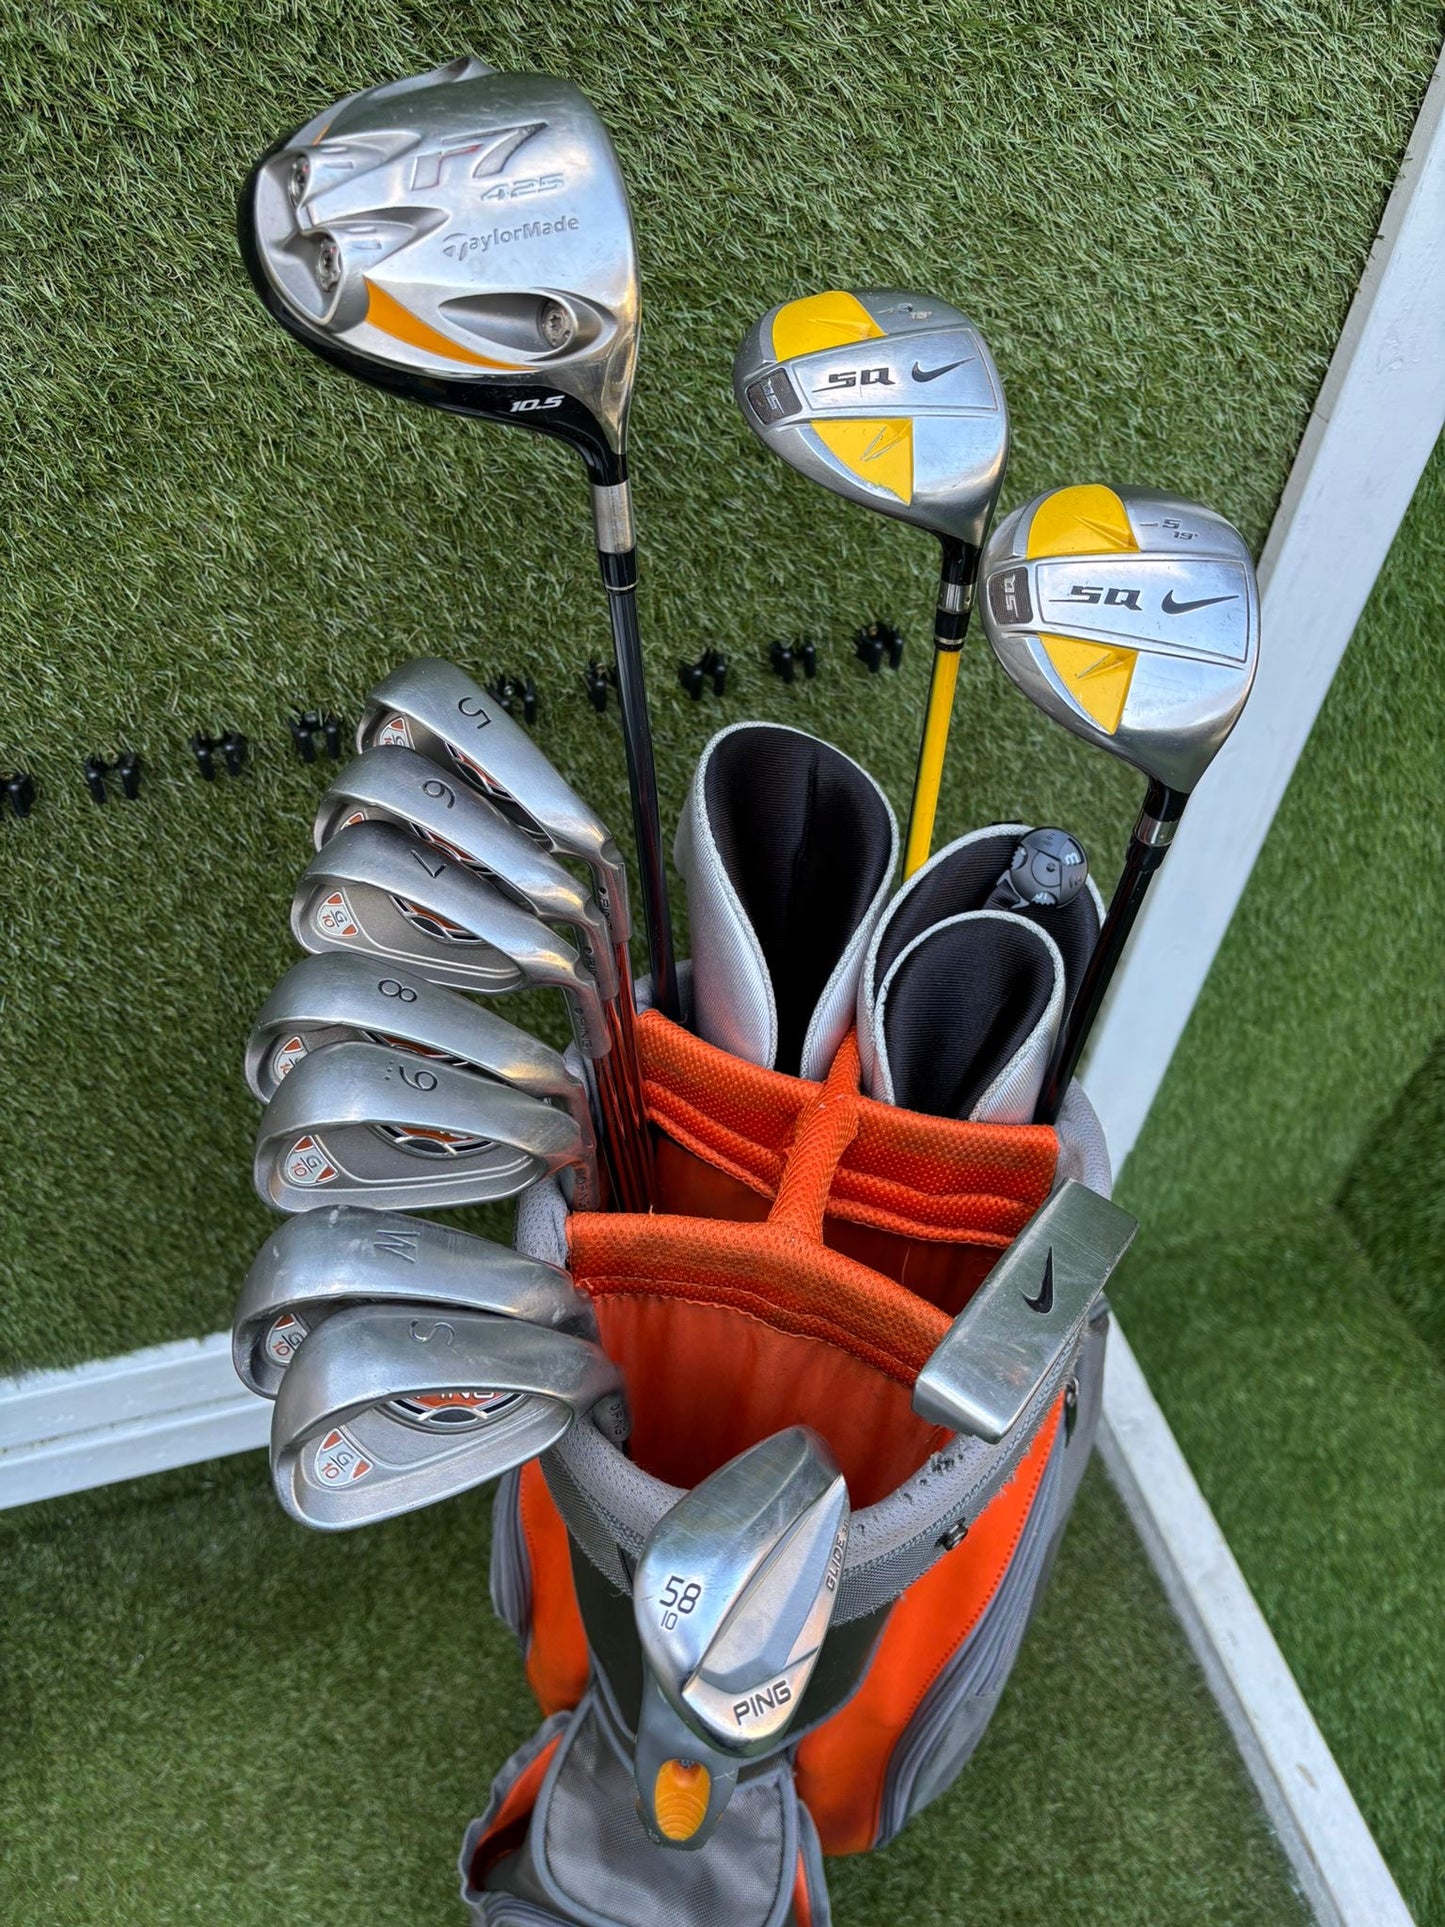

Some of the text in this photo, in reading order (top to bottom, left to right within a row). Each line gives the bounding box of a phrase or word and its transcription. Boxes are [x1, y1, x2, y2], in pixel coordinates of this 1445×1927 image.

[411, 122, 548, 191] r7
[481, 173, 564, 202] 425
[443, 216, 580, 261] TaylorMade
[812, 367, 896, 393] SQ
[510, 394, 564, 413] 10.5
[1048, 586, 1143, 611] SQ
[458, 697, 492, 730] 5
[422, 778, 456, 809] 6
[411, 850, 446, 879] 7
[322, 914, 336, 928] 10
[335, 910, 348, 923] G
[378, 979, 417, 1002] 8
[291, 1162, 307, 1177] 10
[306, 1155, 323, 1169] G
[373, 1229, 421, 1264] W
[408, 1319, 456, 1346] S
[272, 1341, 291, 1356] 10
[321, 1462, 340, 1479] 10
[336, 1452, 354, 1467] G
[825, 1534, 846, 1592] GLIDE
[659, 1575, 702, 1614] 58
[661, 1609, 678, 1630] 10
[733, 1680, 792, 1725] PING
